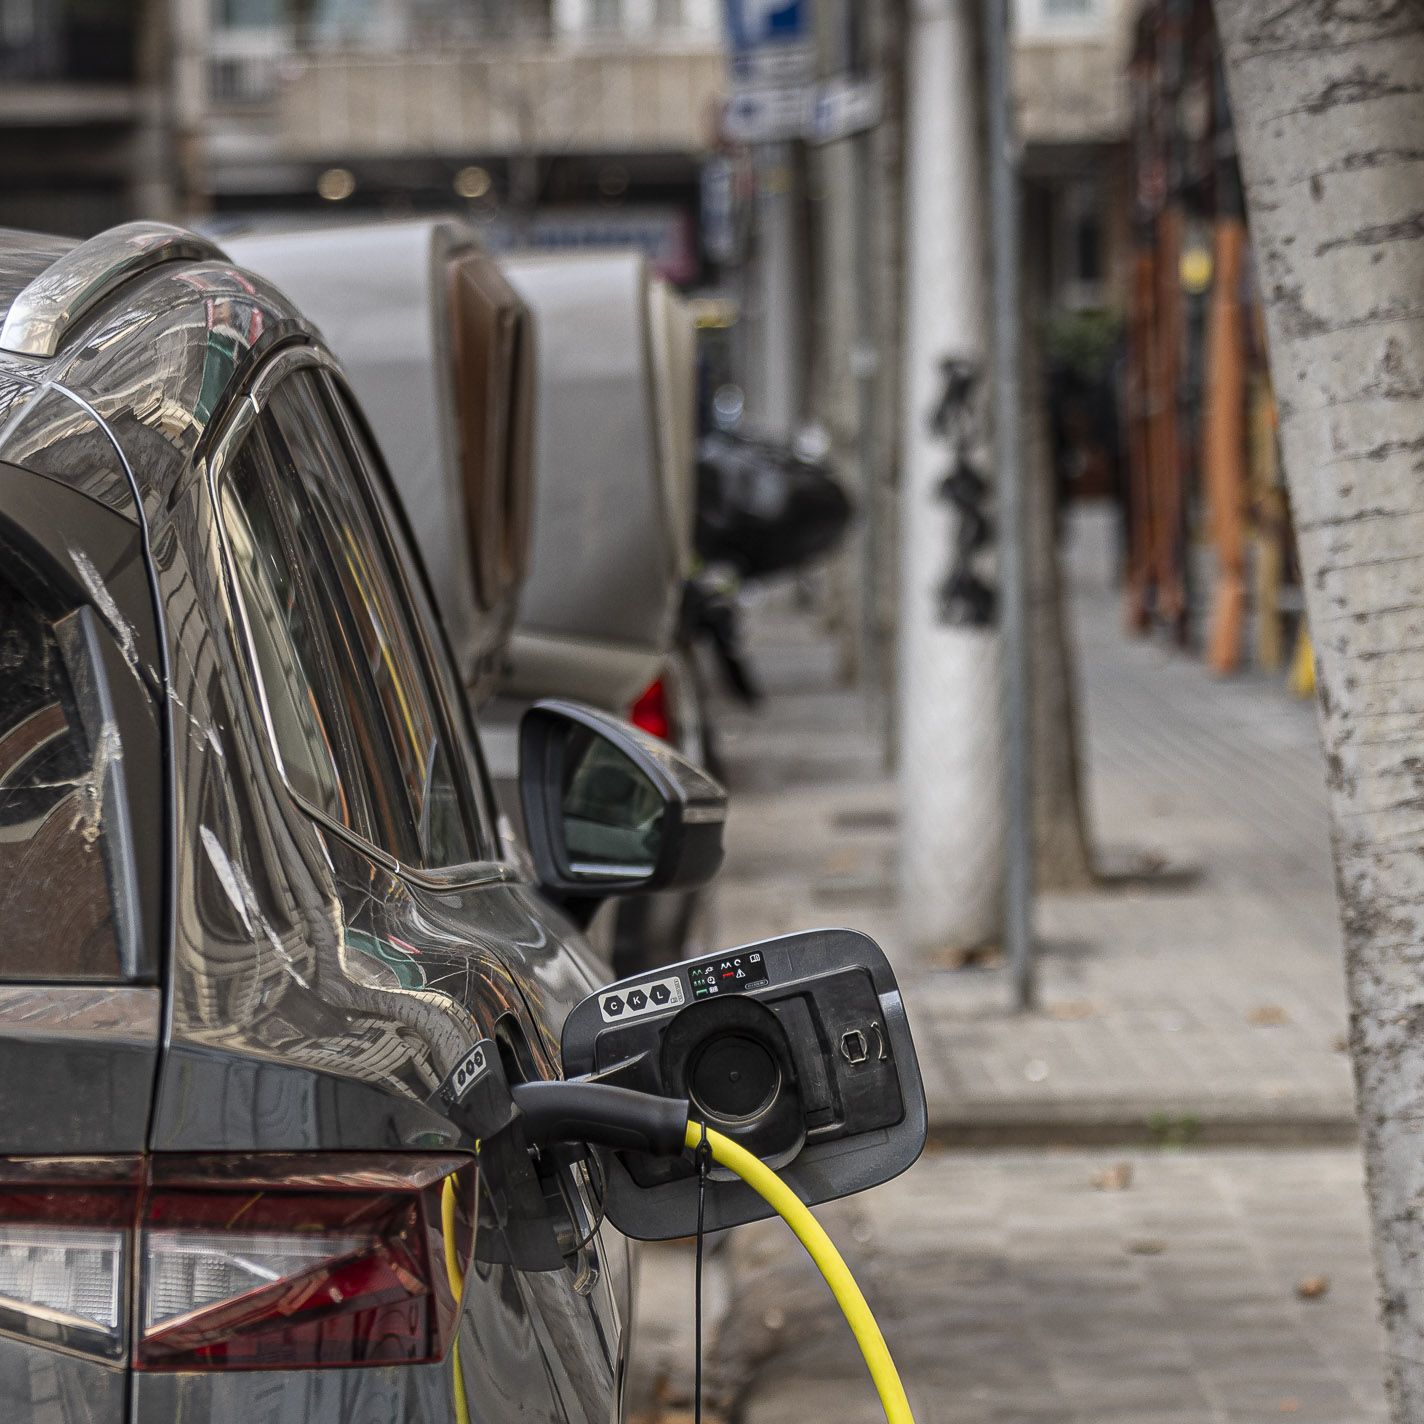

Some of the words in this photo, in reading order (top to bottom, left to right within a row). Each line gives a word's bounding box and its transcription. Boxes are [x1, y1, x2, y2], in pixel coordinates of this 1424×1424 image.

[610, 1002, 618, 1010] C
[632, 996, 641, 1005] K
[656, 991, 664, 999] L
